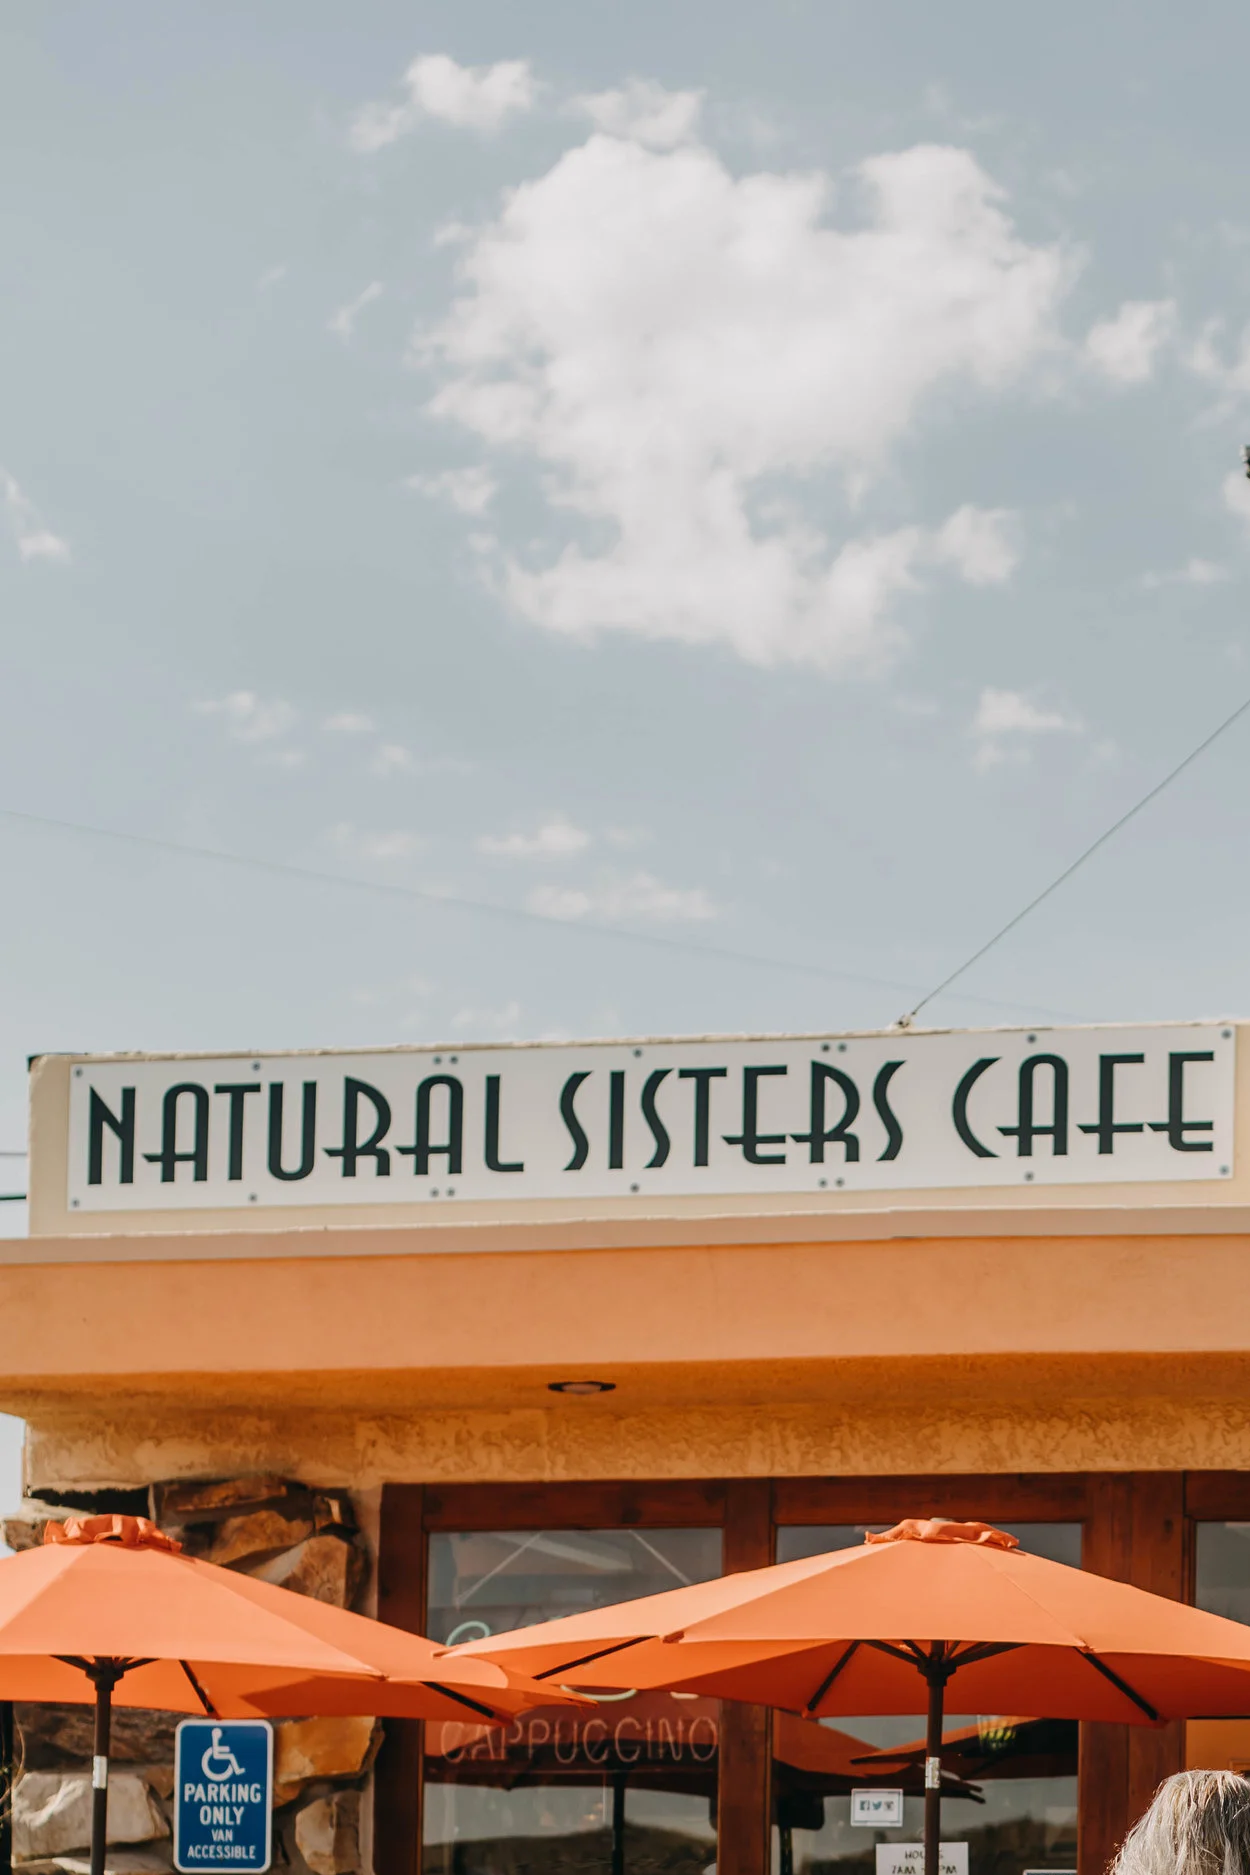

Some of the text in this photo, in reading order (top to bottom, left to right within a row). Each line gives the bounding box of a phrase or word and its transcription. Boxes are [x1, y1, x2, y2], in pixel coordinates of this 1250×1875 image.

[87, 1050, 1216, 1187] NATURAL SISTERS CAFE
[440, 1716, 719, 1764] CAPPUCCINO
[184, 1783, 262, 1804] PARKING
[199, 1805, 245, 1826] ONLY
[211, 1829, 233, 1842] VAN
[187, 1844, 257, 1860] ACCESSIBLE
